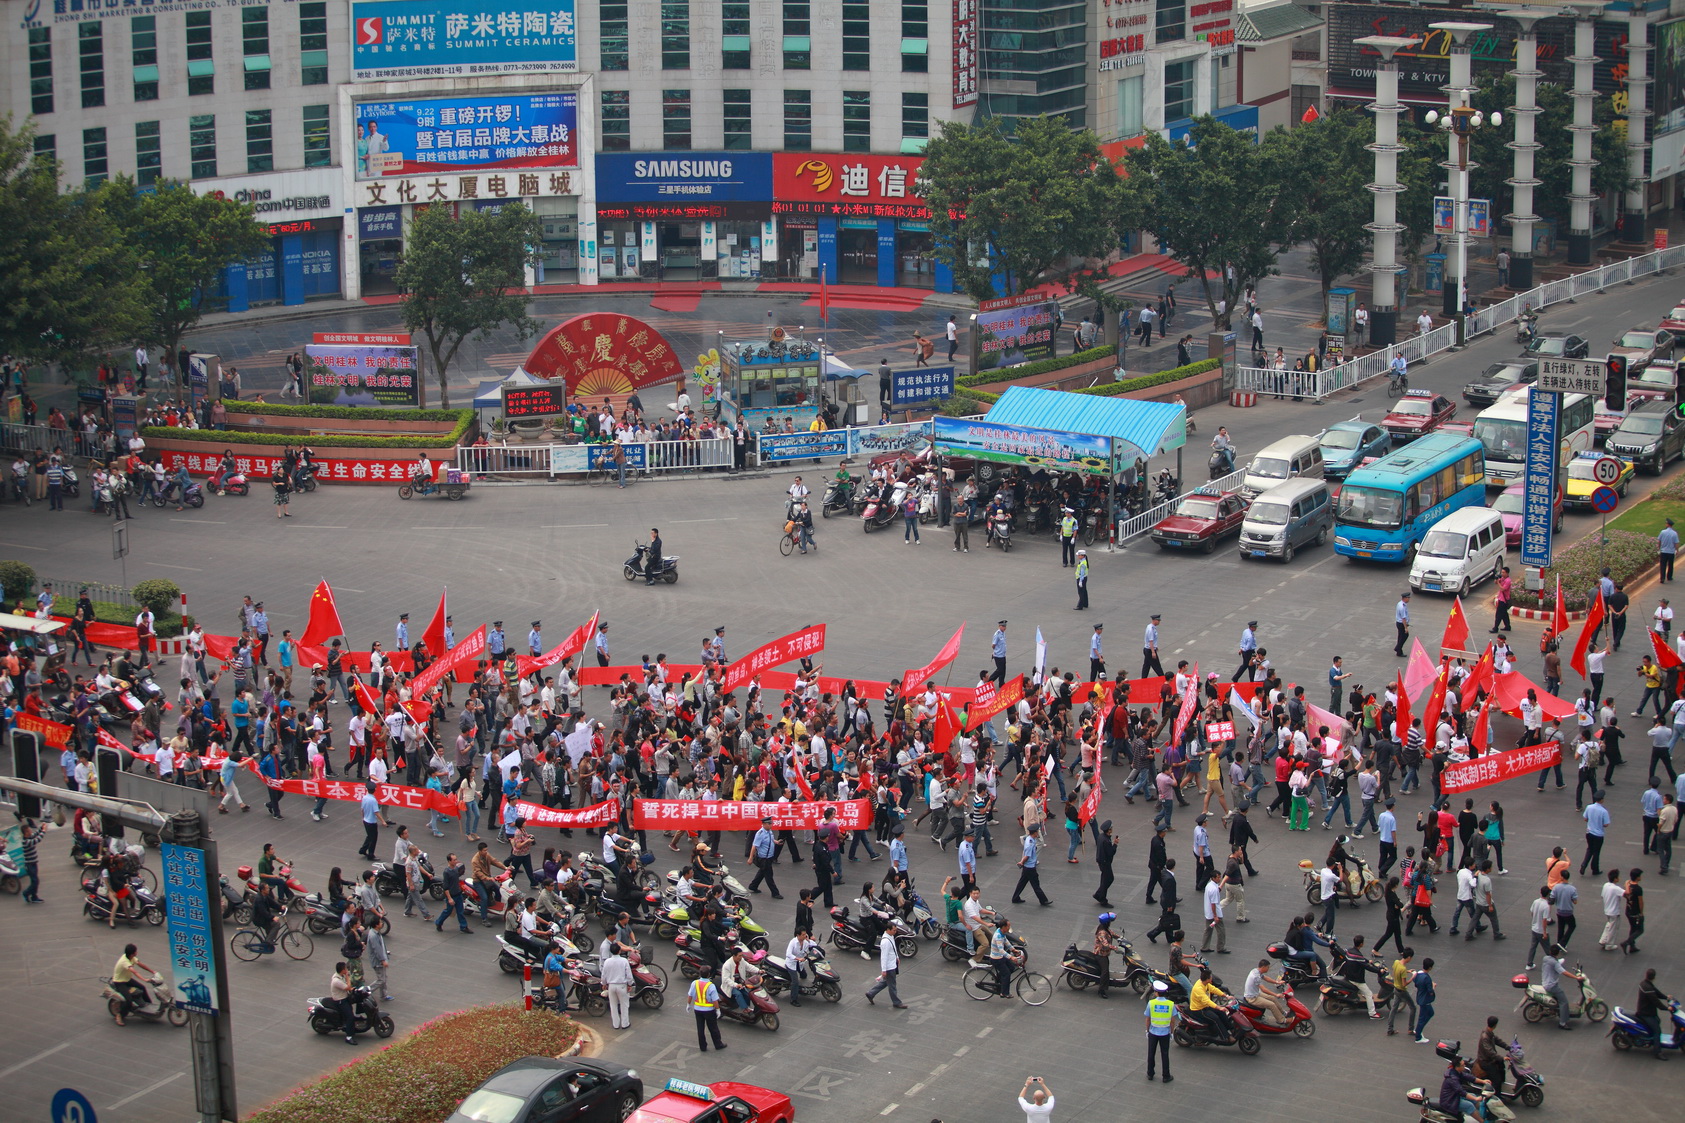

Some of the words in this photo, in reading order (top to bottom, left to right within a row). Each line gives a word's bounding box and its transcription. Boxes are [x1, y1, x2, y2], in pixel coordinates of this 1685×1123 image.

[446, 10, 574, 39] 萨米特陶瓷
[387, 26, 436, 43] 萨米特
[357, 43, 436, 54] 中国驰名商标
[446, 40, 499, 48] SUMMIT
[505, 38, 575, 47] CERAMICS
[1512, 38, 1558, 57] TWN
[1424, 73, 1445, 83] KTV
[416, 108, 435, 116] 9.22
[417, 116, 435, 128] 9时
[416, 124, 569, 150] 暨首届品牌大惠战
[416, 148, 490, 163] 百姓省钱集中赢
[495, 145, 570, 158] 价格解放全桂林
[635, 160, 732, 178] SAMSUNG
[234, 189, 271, 203] China
[366, 172, 572, 206] 文化大厦电脑城
[658, 185, 712, 195] 三星手机体验店
[283, 195, 331, 211] 中国联通
[362, 210, 398, 223] 步步高
[982, 320, 1015, 335] 文明桂林
[1019, 312, 1052, 328] 我的责任
[982, 336, 1015, 353] 桂林文明
[1019, 329, 1051, 346] 我的光荣
[312, 356, 358, 368] 文明桂林
[365, 357, 411, 369] 我的责任
[312, 374, 359, 387] 桂林文明
[366, 375, 412, 388] 我的光荣
[897, 373, 949, 387] 规范执法行为
[897, 386, 949, 399] 创建和谐交通
[1600, 463, 1615, 479] 50
[1208, 723, 1233, 732] 誓死
[1208, 731, 1233, 741] 保钓
